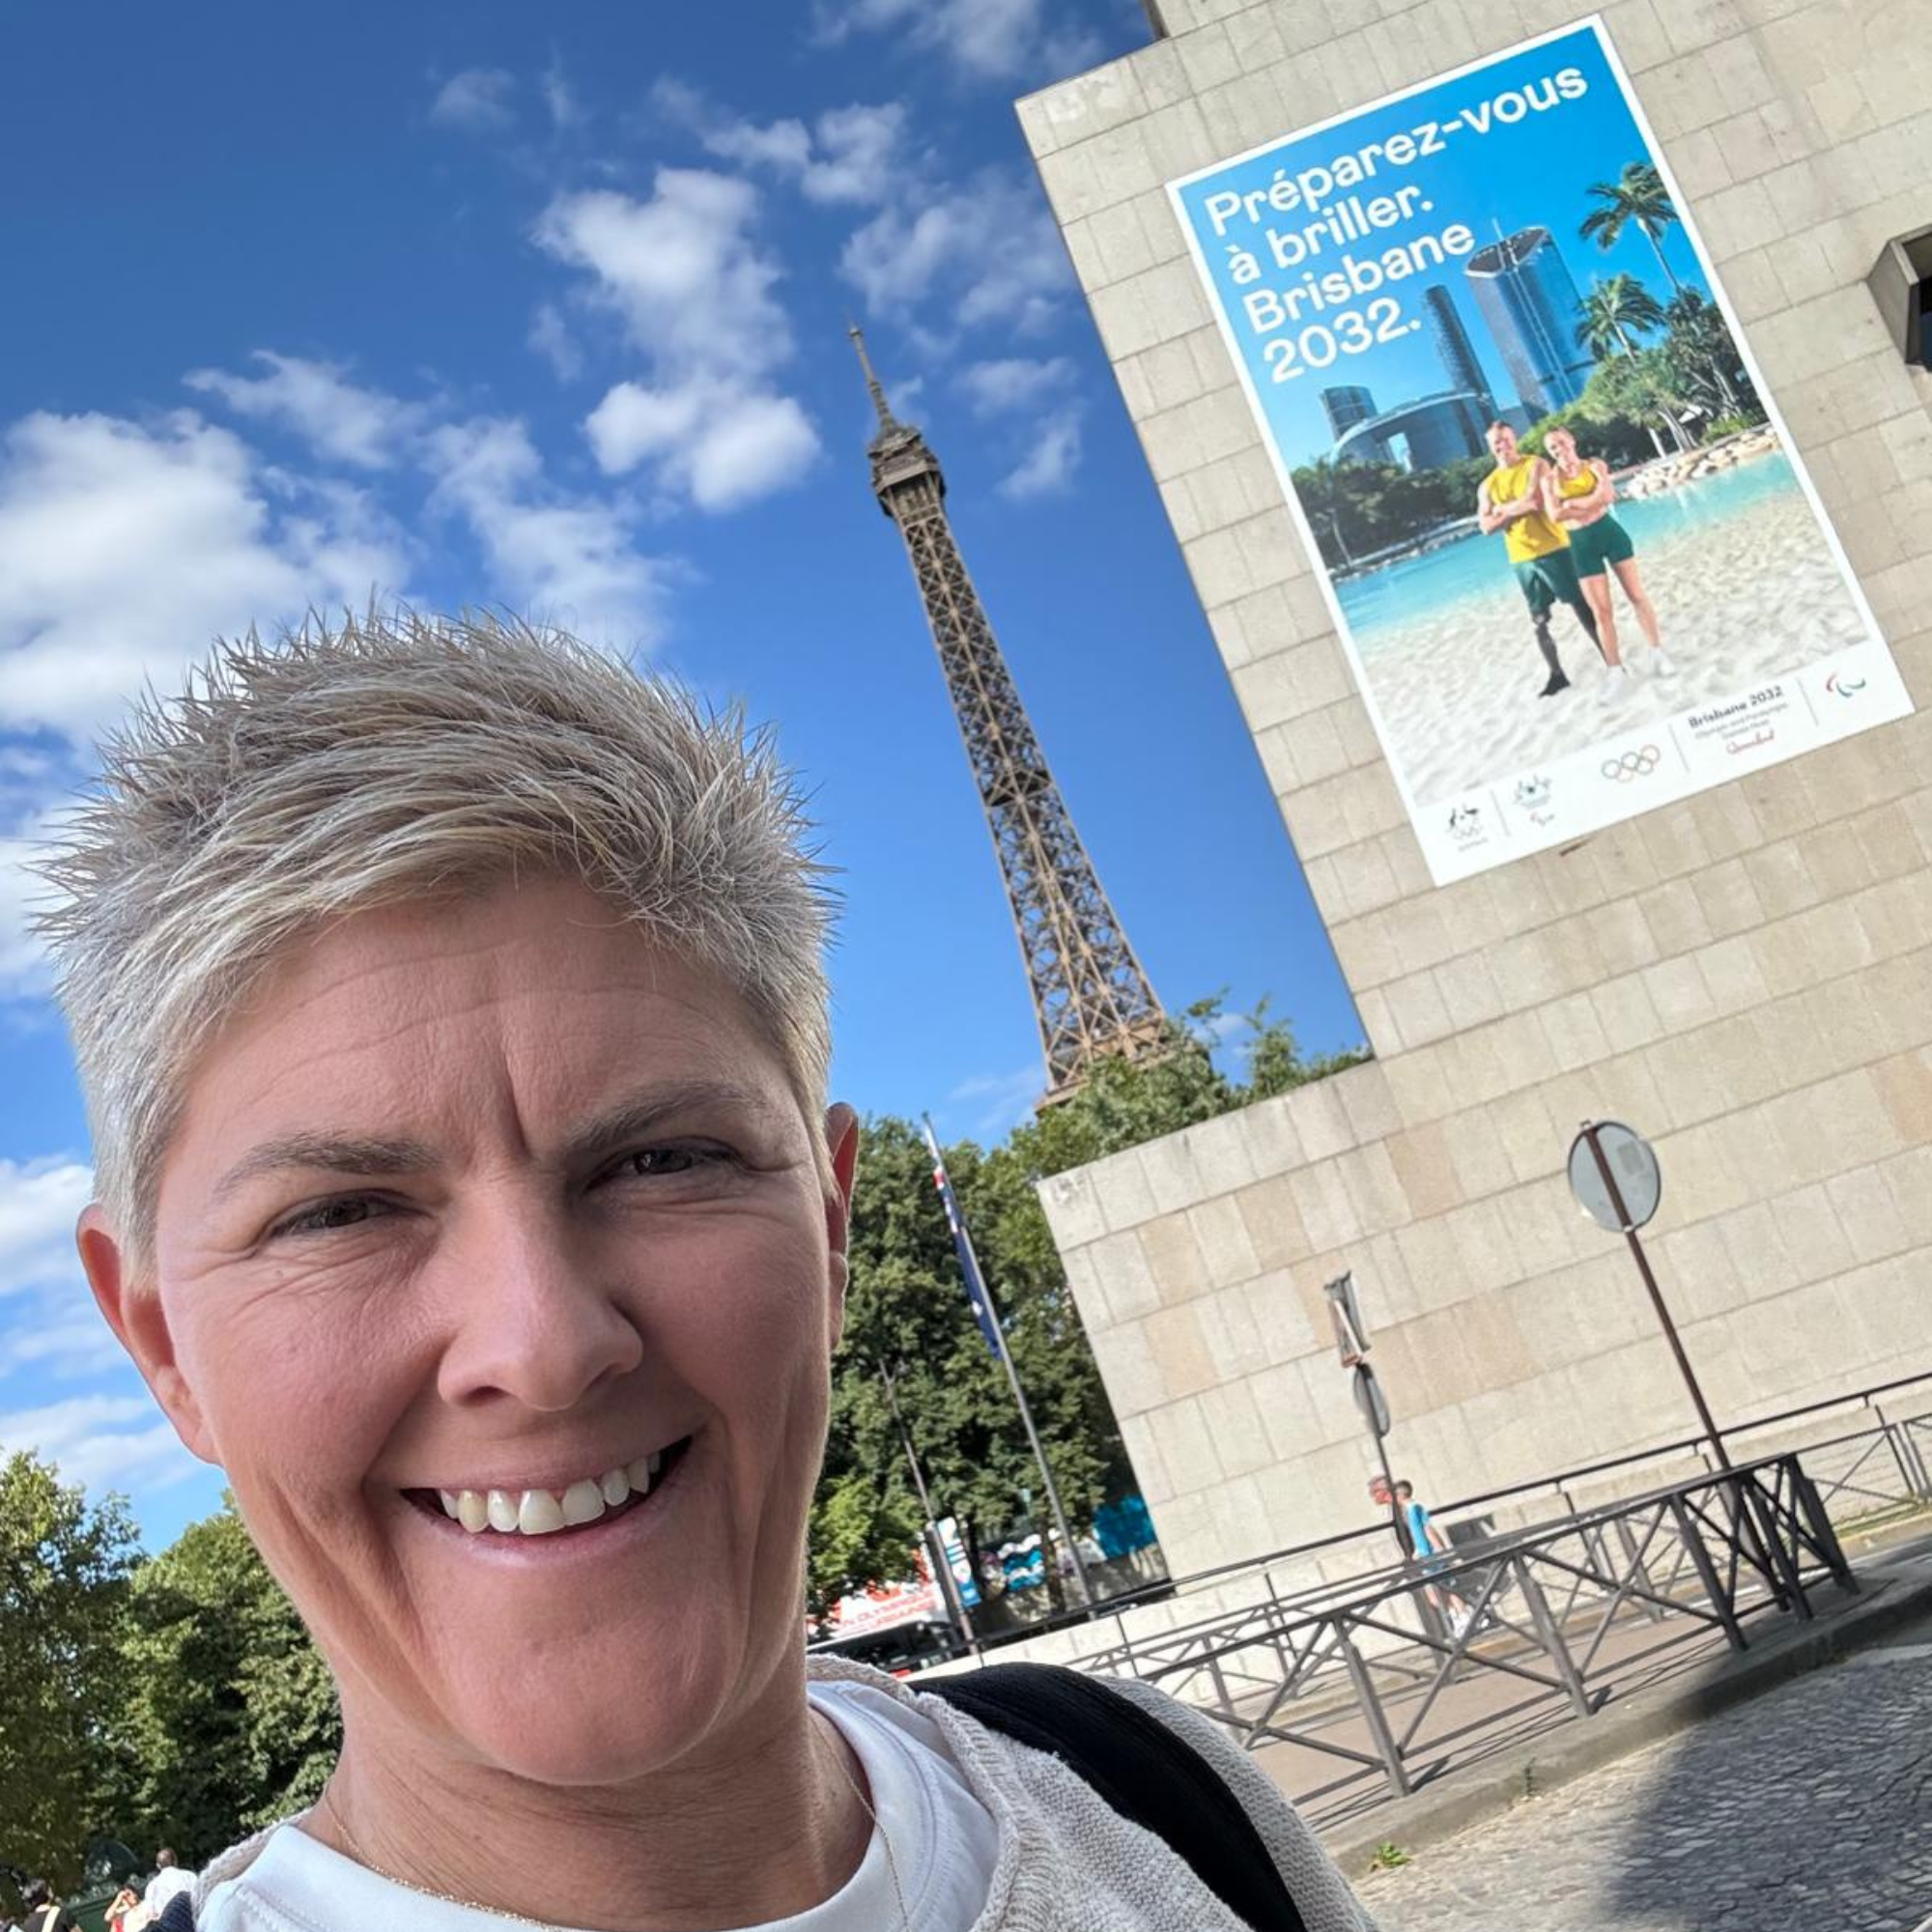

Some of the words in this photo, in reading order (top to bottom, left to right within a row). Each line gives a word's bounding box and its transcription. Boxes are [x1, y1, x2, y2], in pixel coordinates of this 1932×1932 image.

[1205, 66, 1587, 236] Préparez-vous
[1225, 243, 1262, 285] à
[1265, 184, 1434, 270] briller.
[1241, 222, 1475, 335] Brisbane
[1262, 296, 1422, 384] 2032.
[1688, 705, 1747, 729] Brisbane
[1749, 684, 1783, 707] 2032
